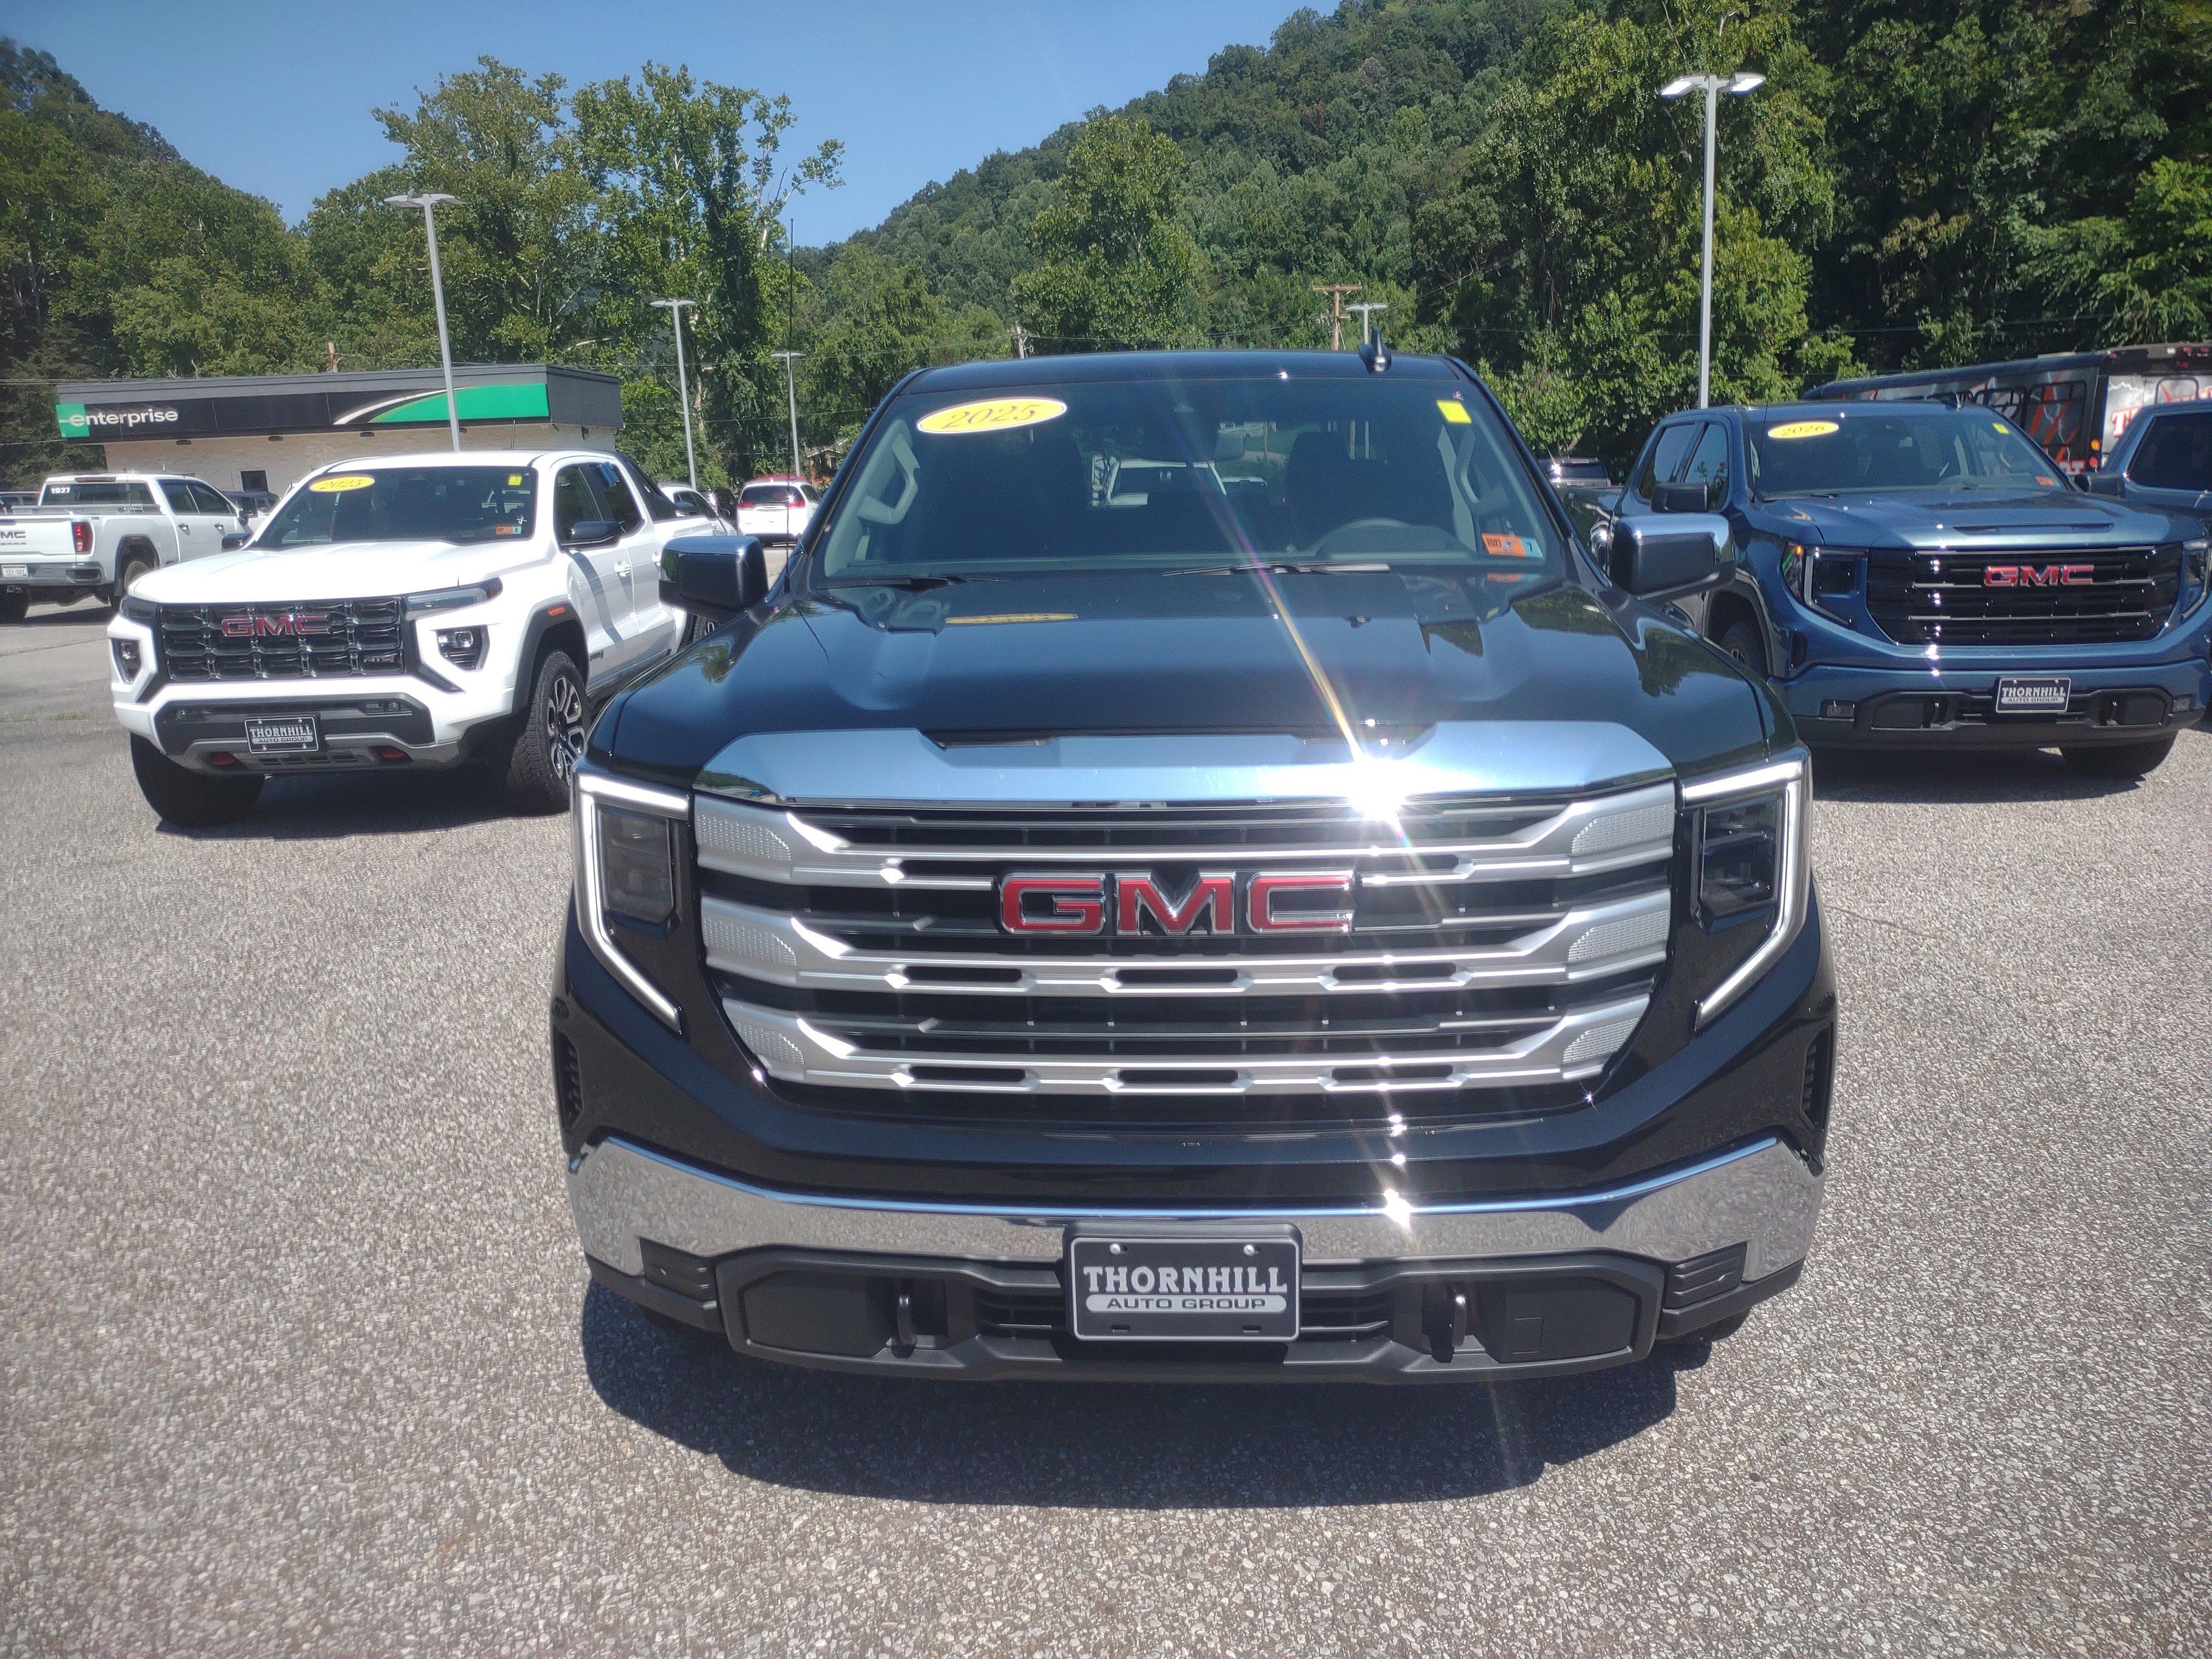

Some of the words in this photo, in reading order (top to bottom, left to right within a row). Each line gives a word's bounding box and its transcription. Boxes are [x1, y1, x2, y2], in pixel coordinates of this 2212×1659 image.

[70, 409, 179, 427] enterprise
[941, 404, 1041, 429] 2025
[319, 479, 364, 489] 2025
[1984, 565, 2095, 587] GMC
[222, 614, 330, 637] GMC
[2002, 686, 2066, 697] THORNHILL
[250, 726, 313, 738] THORNHILL
[1000, 869, 1354, 936] GMC
[1083, 1266, 1287, 1293] THORNHILL
[1107, 1297, 1173, 1309] AUTO
[1181, 1297, 1266, 1309] GROUP
